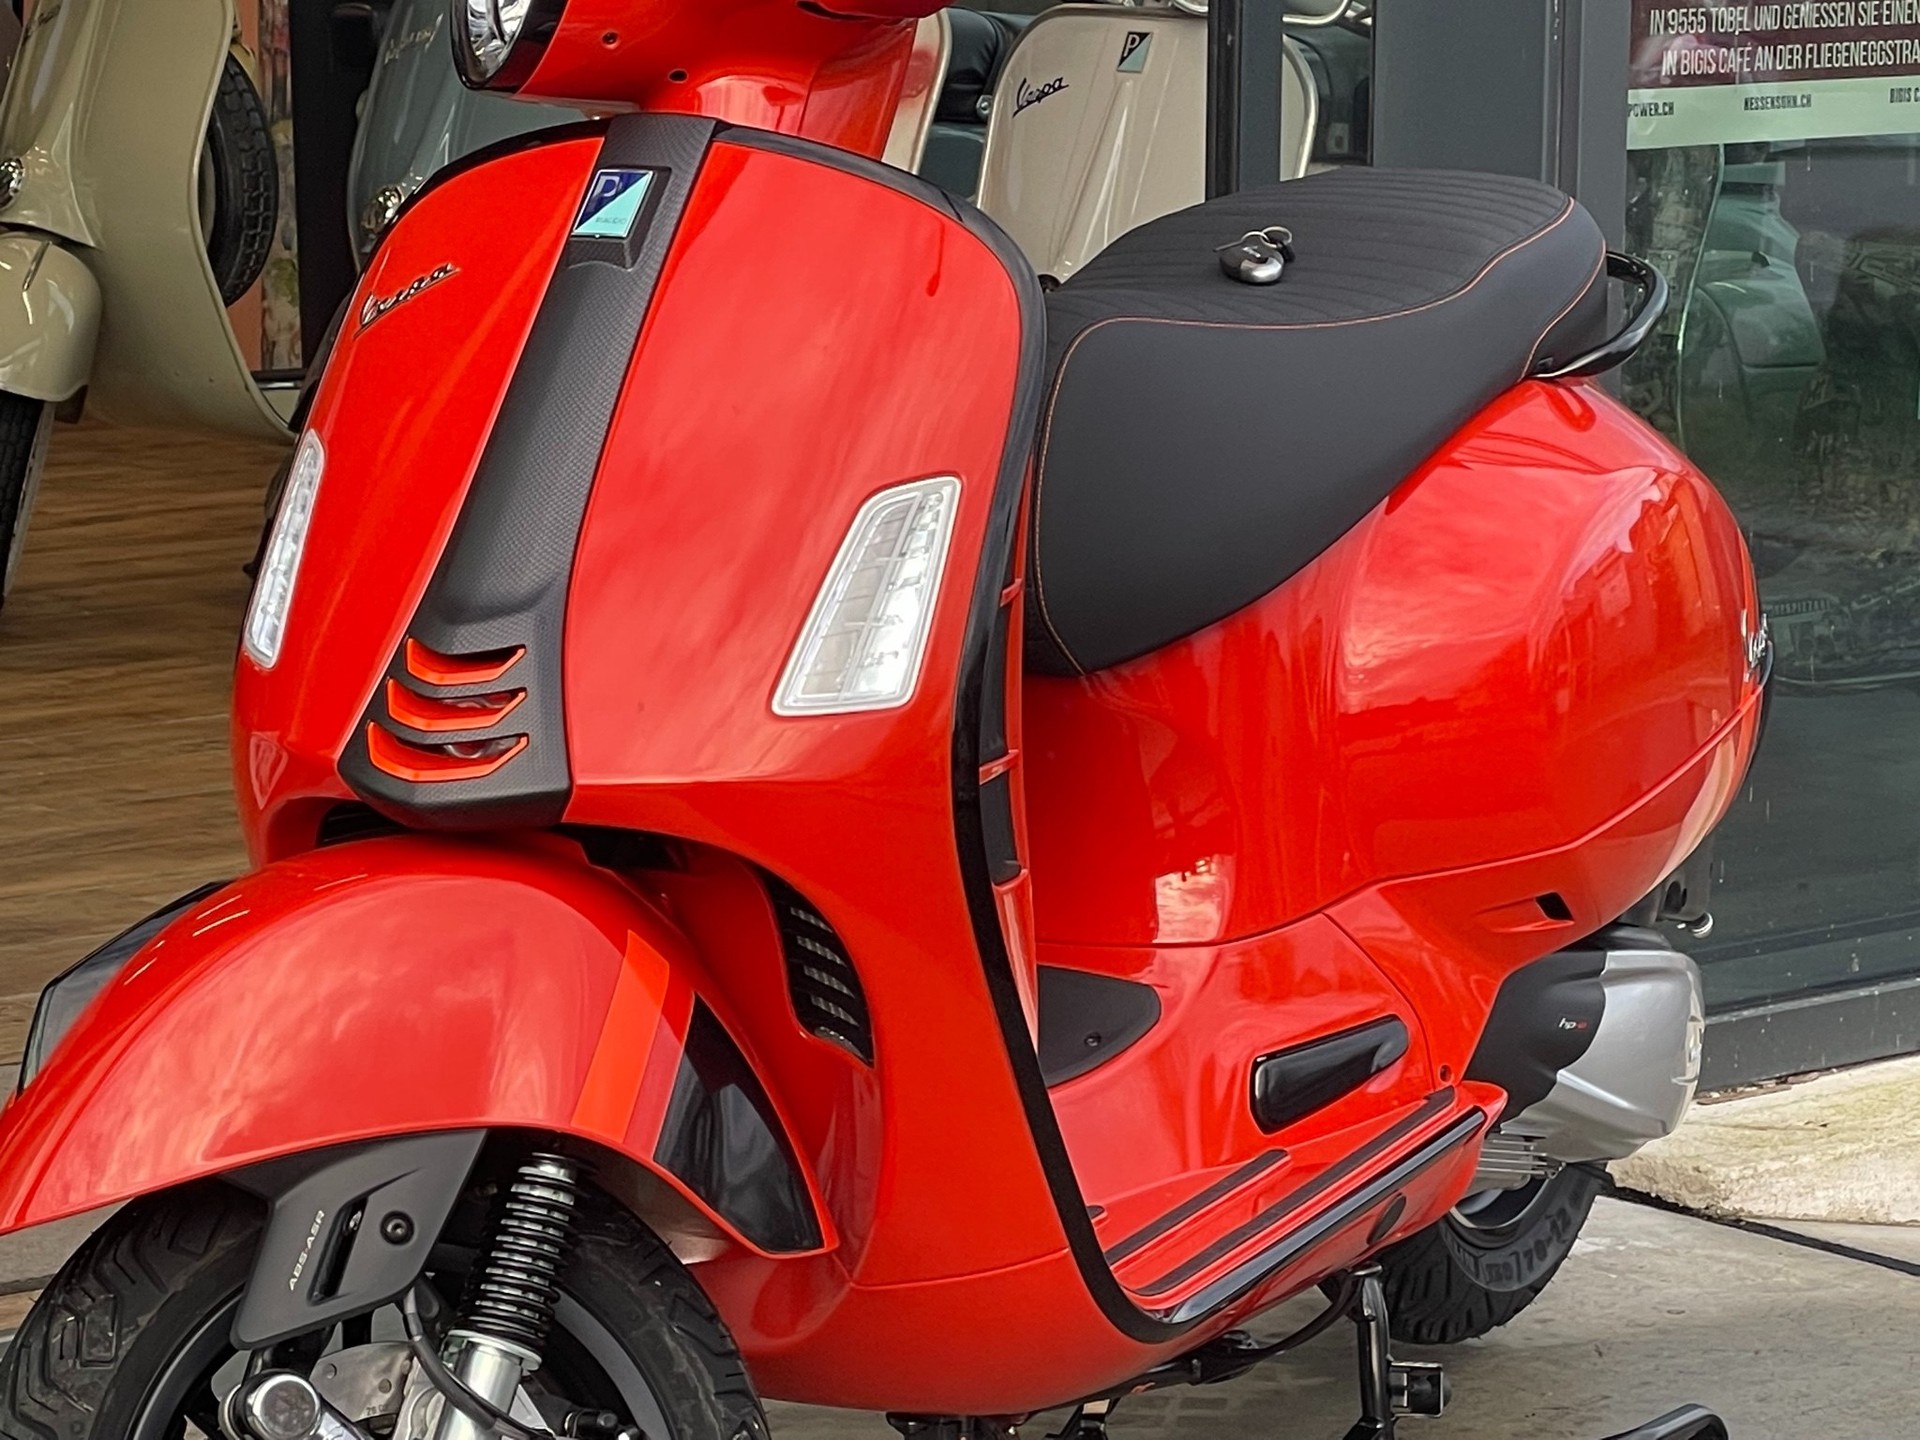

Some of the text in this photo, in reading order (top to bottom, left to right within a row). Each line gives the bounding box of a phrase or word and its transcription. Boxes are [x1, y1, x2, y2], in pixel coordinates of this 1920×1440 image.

[1649, 9, 1665, 36] IN
[1668, 8, 1707, 34] 9555
[1710, 6, 1751, 33] TOBEL
[1754, 5, 1780, 31] UND
[1783, 1, 1855, 29] GENIESSEN
[1858, 0, 1879, 26] SIE
[1661, 50, 1678, 76] IN
[1680, 48, 1717, 75] BIGIS
[1754, 45, 1774, 72] AN
[1776, 44, 1802, 71] DER
[1012, 77, 1069, 118] Vespa
